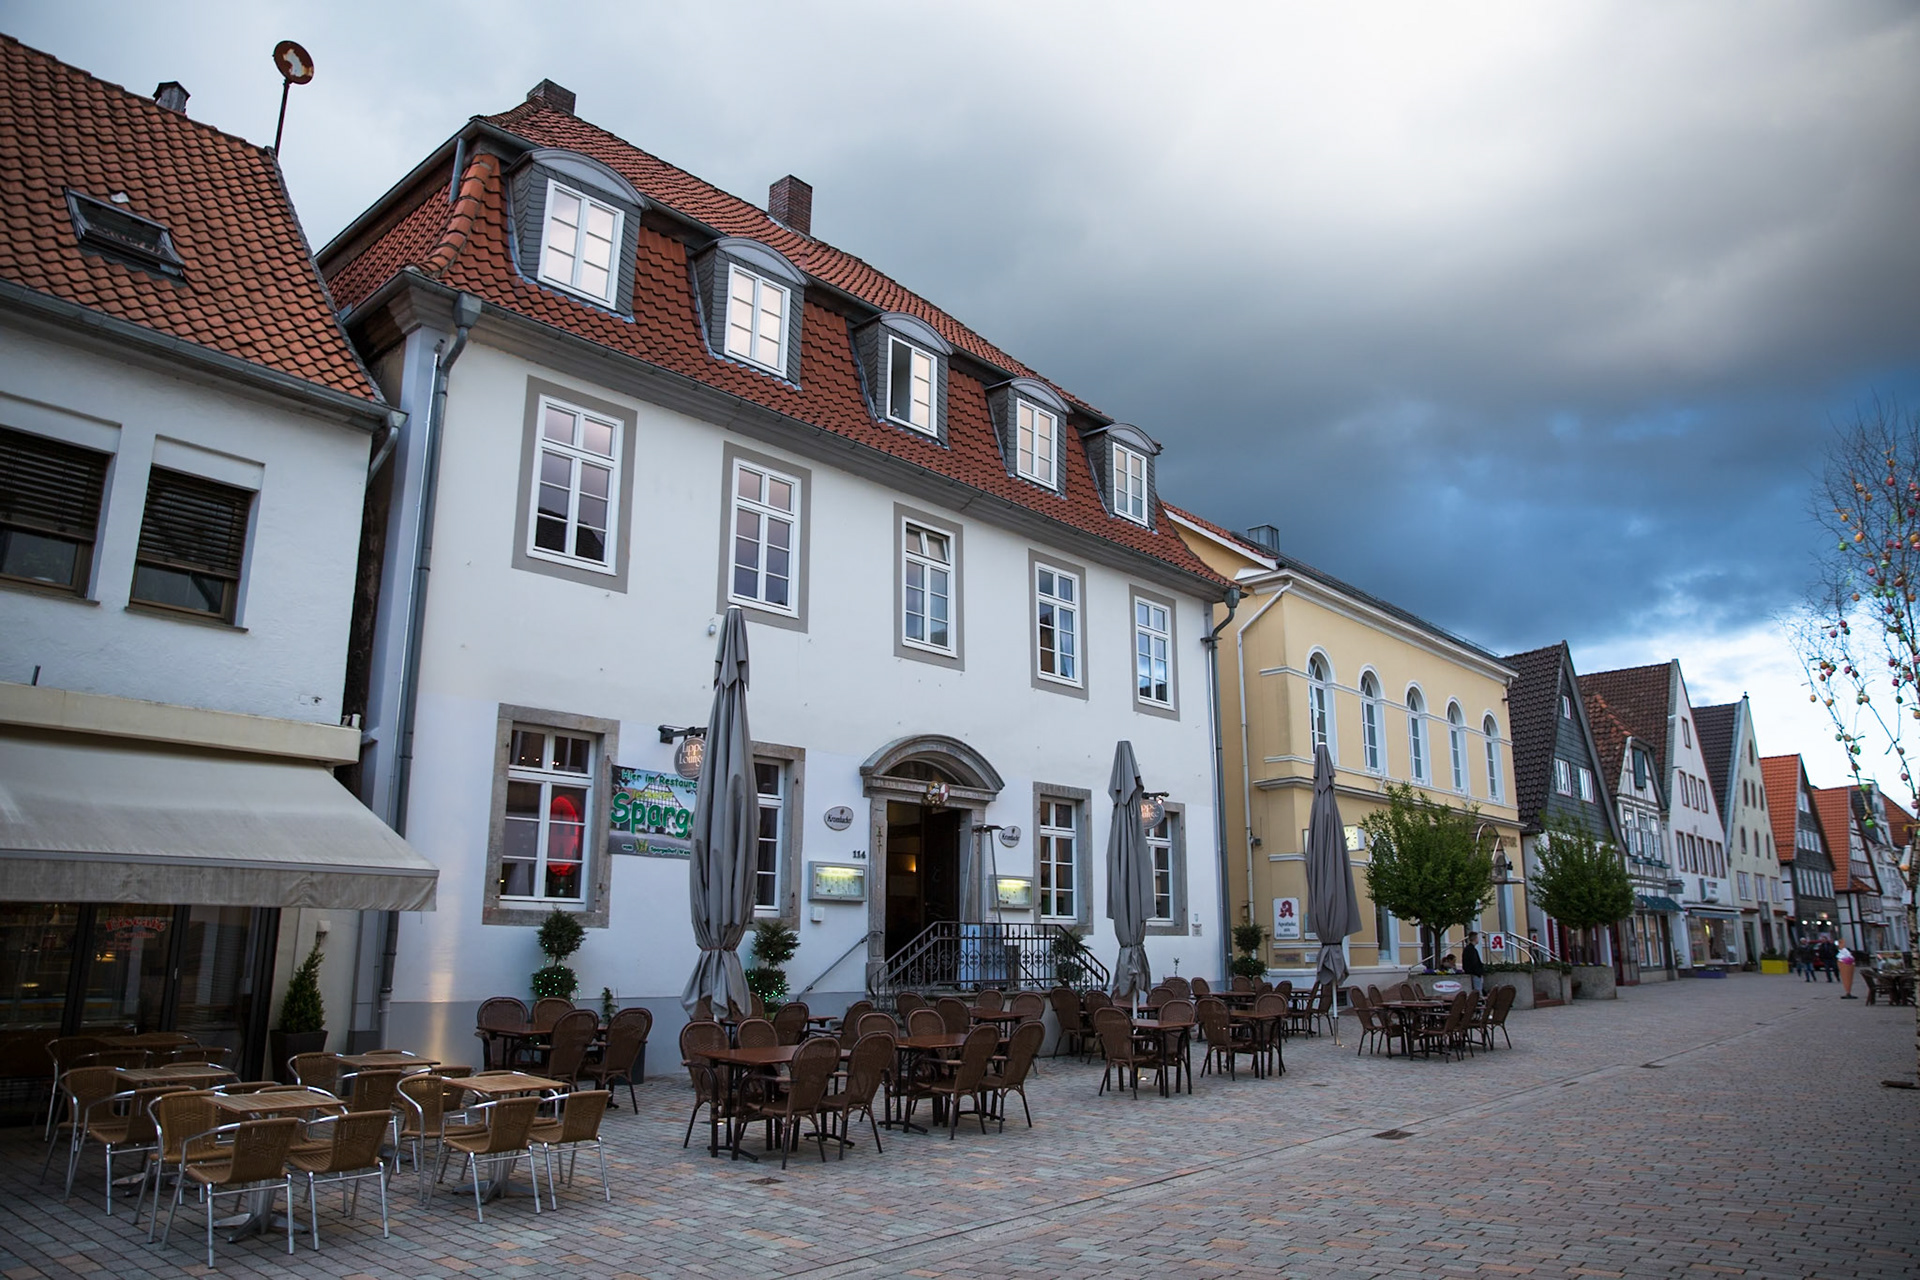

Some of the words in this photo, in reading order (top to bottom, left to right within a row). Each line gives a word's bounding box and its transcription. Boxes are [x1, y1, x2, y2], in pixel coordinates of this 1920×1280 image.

[679, 753, 703, 767] Loung
[621, 769, 642, 783] Hier
[645, 773, 655, 783] im
[659, 775, 698, 789] Restaura
[610, 792, 695, 839] Sparg
[852, 850, 866, 859] 114
